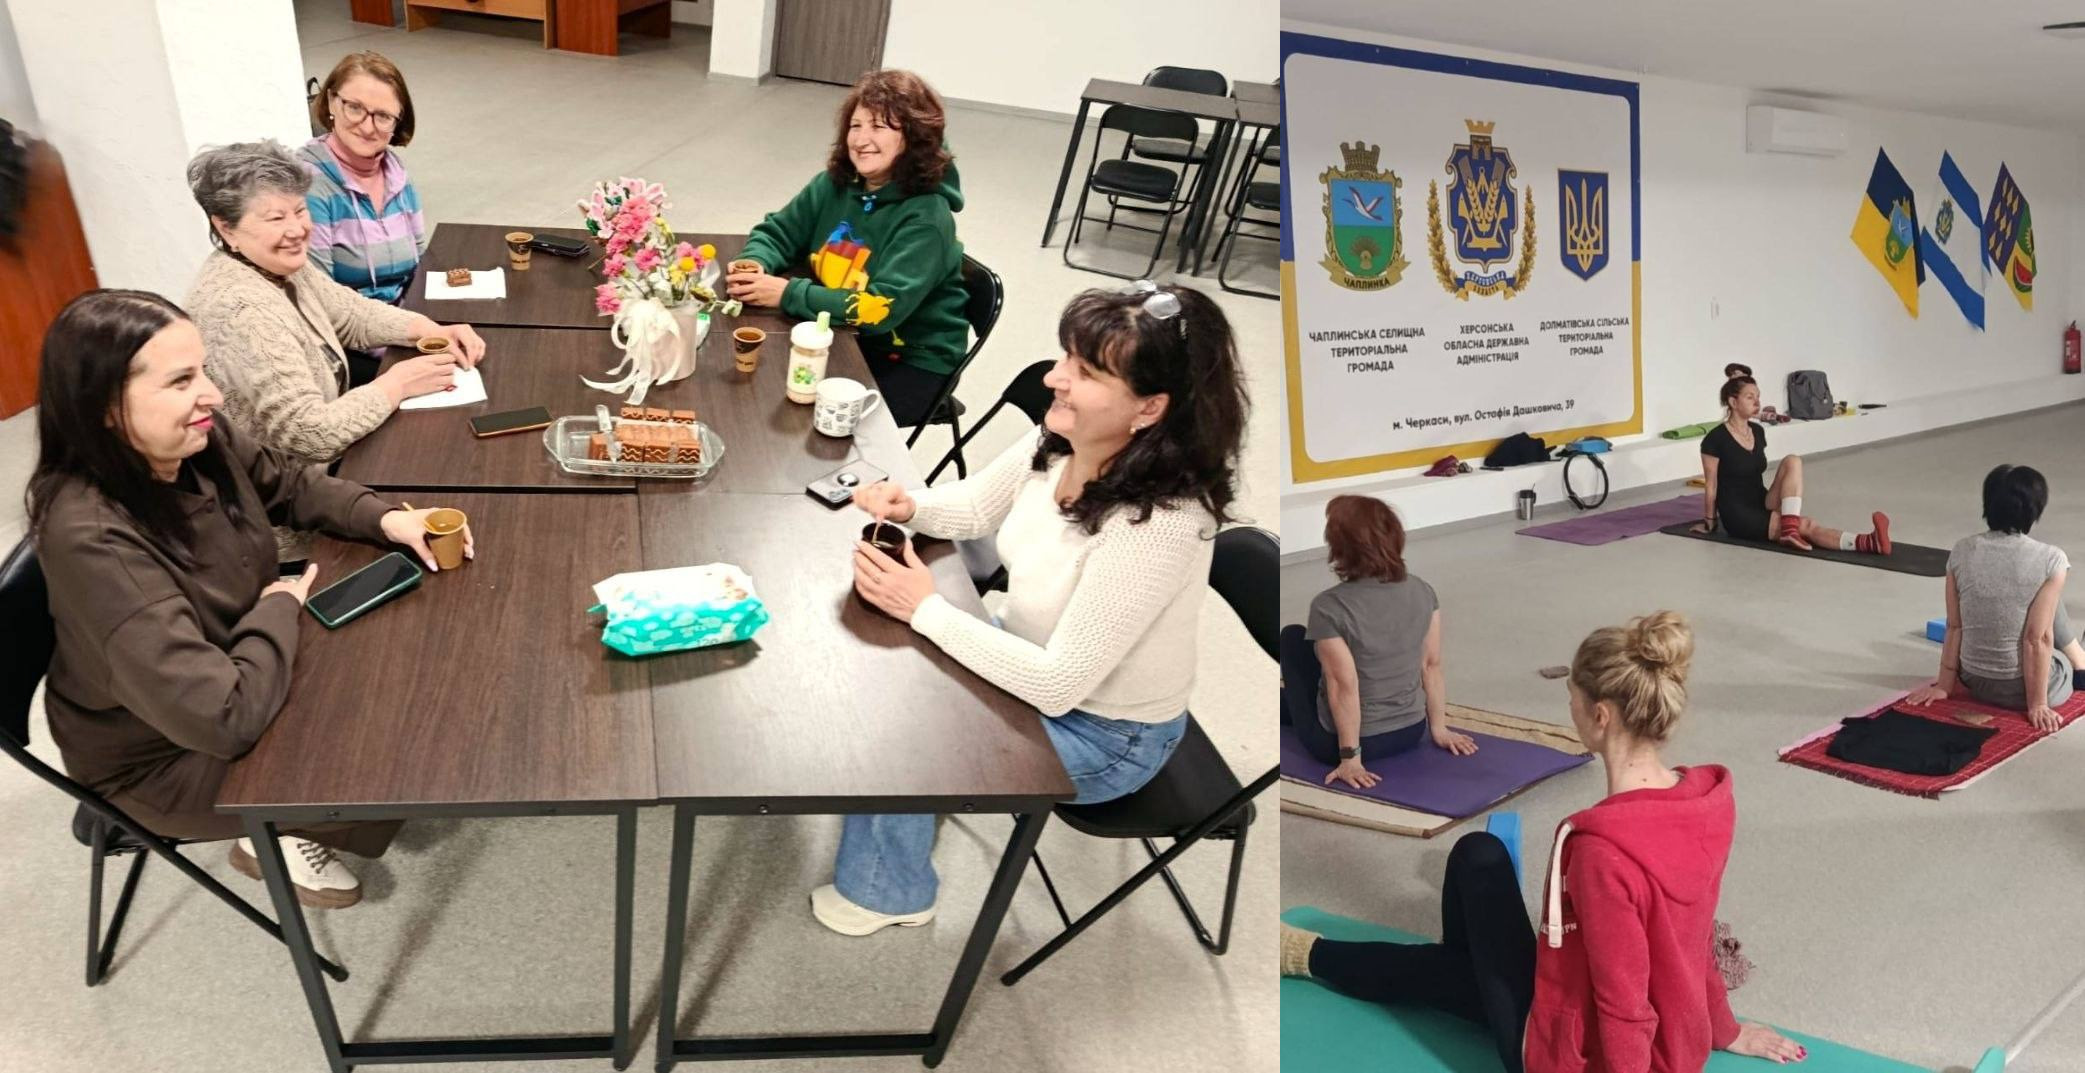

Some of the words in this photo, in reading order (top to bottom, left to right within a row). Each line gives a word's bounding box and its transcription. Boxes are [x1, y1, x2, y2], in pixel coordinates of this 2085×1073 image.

[1344, 276, 1390, 289] ЧАПЛИНКА
[1460, 323, 1514, 334] ХЕРСОНСЬКА
[1540, 318, 1595, 331] ДОЛМАТІВСЬКА
[1597, 317, 1629, 328] СІЛЬСЬКА
[1309, 329, 1377, 342] ЧАПЛИНСЬКА
[1379, 327, 1425, 340] СЕЛИЩНА
[1559, 331, 1613, 343] ТЕРИТОРІАЛЬНА
[1331, 343, 1408, 358] ТЕРИТОРІАЛЬНА
[1443, 339, 1484, 351] ОБЛАСНА
[1486, 336, 1529, 349] ДЕРЖАВНА
[1570, 345, 1603, 356] ГРОМАДА
[1457, 351, 1519, 366] АДМІНІСТРАЦІЯ
[1347, 360, 1394, 373] ГРОМАДА
[1393, 421, 1403, 430] м.
[1405, 417, 1452, 430] Черкаси,
[1454, 414, 1472, 426] вул.
[1474, 407, 1511, 421] Остафія
[1512, 402, 1564, 417] Дашковича,
[1565, 399, 1575, 410] 39
